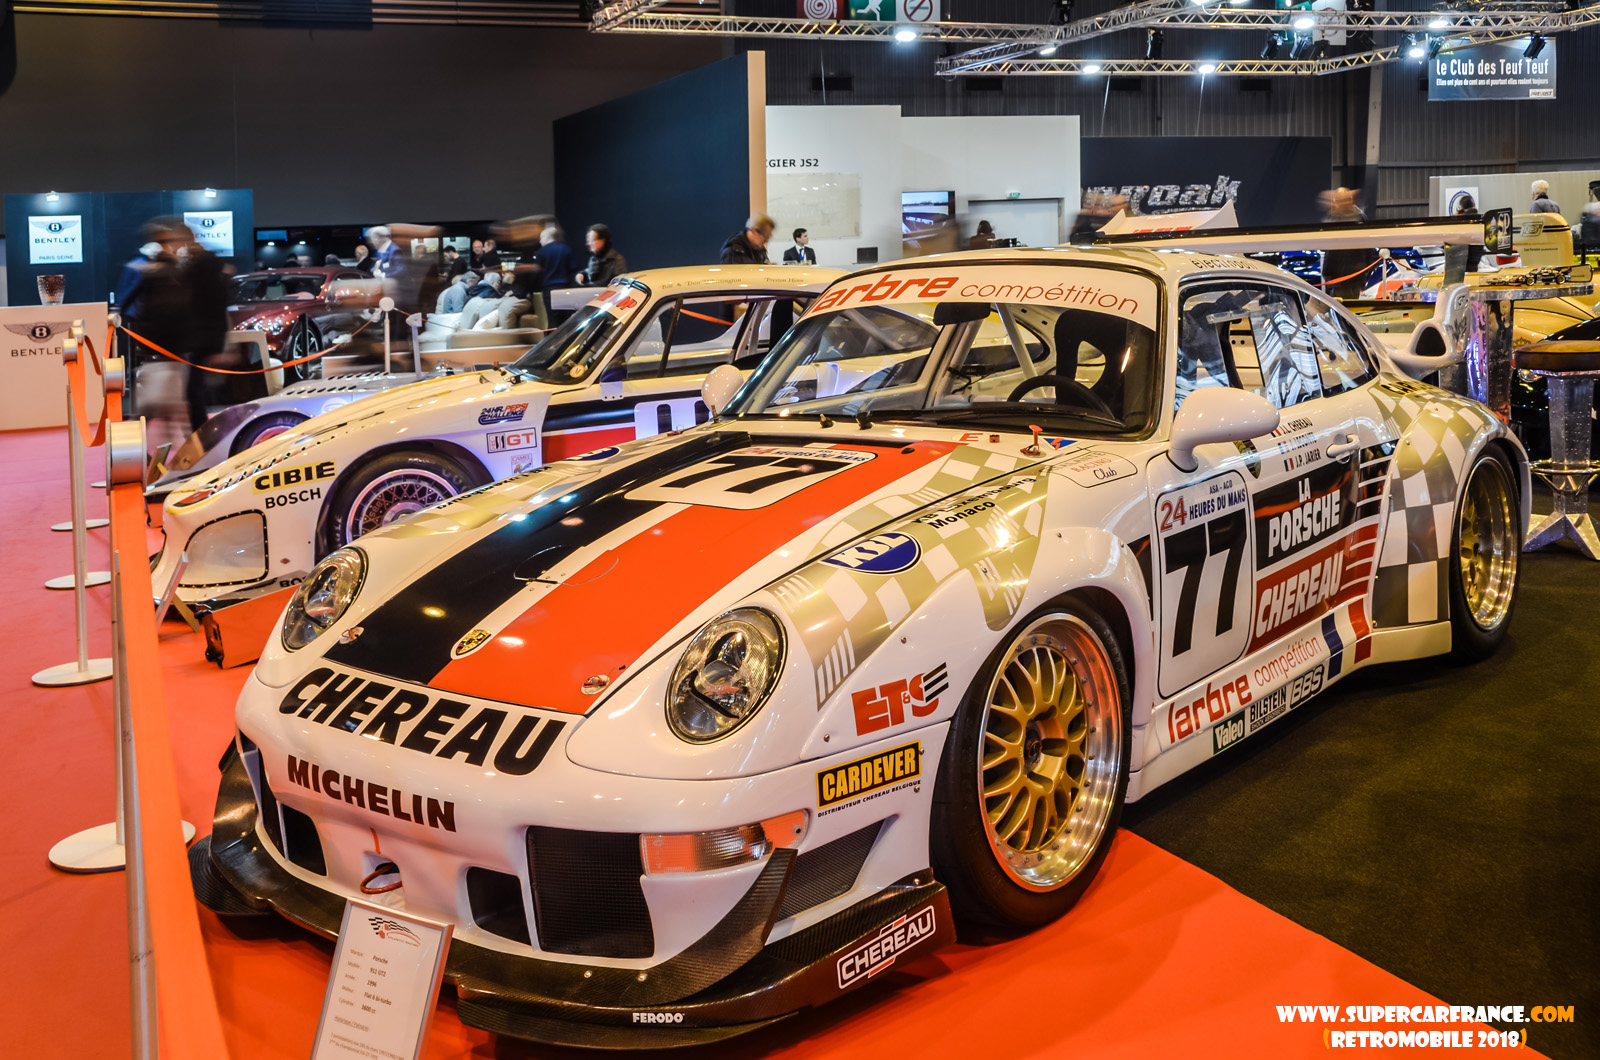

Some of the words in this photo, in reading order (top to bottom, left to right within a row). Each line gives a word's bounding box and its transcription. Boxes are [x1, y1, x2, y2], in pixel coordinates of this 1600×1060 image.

[1436, 59, 1447, 75] le
[1450, 59, 1474, 75] Club
[1478, 59, 1496, 75] des
[1500, 58, 1522, 75] Teuf
[1525, 58, 1549, 75] Teuf
[1436, 78, 1446, 86] Elles
[1454, 78, 1463, 87] plus
[800, 158, 819, 168] JS2
[195, 231, 228, 239] ENTLEY
[806, 274, 960, 316] larbre
[960, 281, 1138, 315] compétition
[11, 347, 61, 357] BENTLE
[478, 410, 526, 424] CHALLENGE
[505, 403, 529, 411] PEPSI
[506, 432, 534, 446] GT
[959, 433, 984, 442] E
[1071, 458, 1112, 473] RACING
[1305, 448, 1321, 464] JARIER
[659, 455, 852, 495] 77
[1094, 467, 1118, 481] Club
[265, 487, 322, 509] BOSCH
[1209, 484, 1220, 494] ASA
[1223, 480, 1233, 490] ACO
[1299, 478, 1311, 503] LA
[928, 501, 996, 529] Monaco
[1160, 495, 1188, 533] 24
[1189, 498, 1216, 521] HEURES
[1217, 496, 1227, 509] DU
[1228, 489, 1246, 507] MANS
[1268, 490, 1341, 558] PORSCHE
[832, 533, 910, 568] KBL
[279, 577, 306, 588] BO
[1164, 508, 1248, 658] 77
[1255, 550, 1344, 638] CHEREAU
[1168, 674, 1252, 744] larbre
[1254, 636, 1322, 687] compétition
[1290, 664, 1325, 709] BBS
[1250, 686, 1286, 723] BILSTEIN
[279, 667, 567, 776] CHEREAU
[1215, 717, 1244, 749] Valeo
[822, 747, 916, 801] CARDEVER
[287, 754, 456, 832] MICHELIN
[817, 799, 861, 818] DISTRIBUTEUR
[862, 789, 890, 803] CHEREAU
[891, 780, 921, 793] BELGIQUE
[841, 912, 932, 982] CHEREAU
[373, 955, 389, 965] Porsche
[632, 1012, 684, 1024] FERODO
